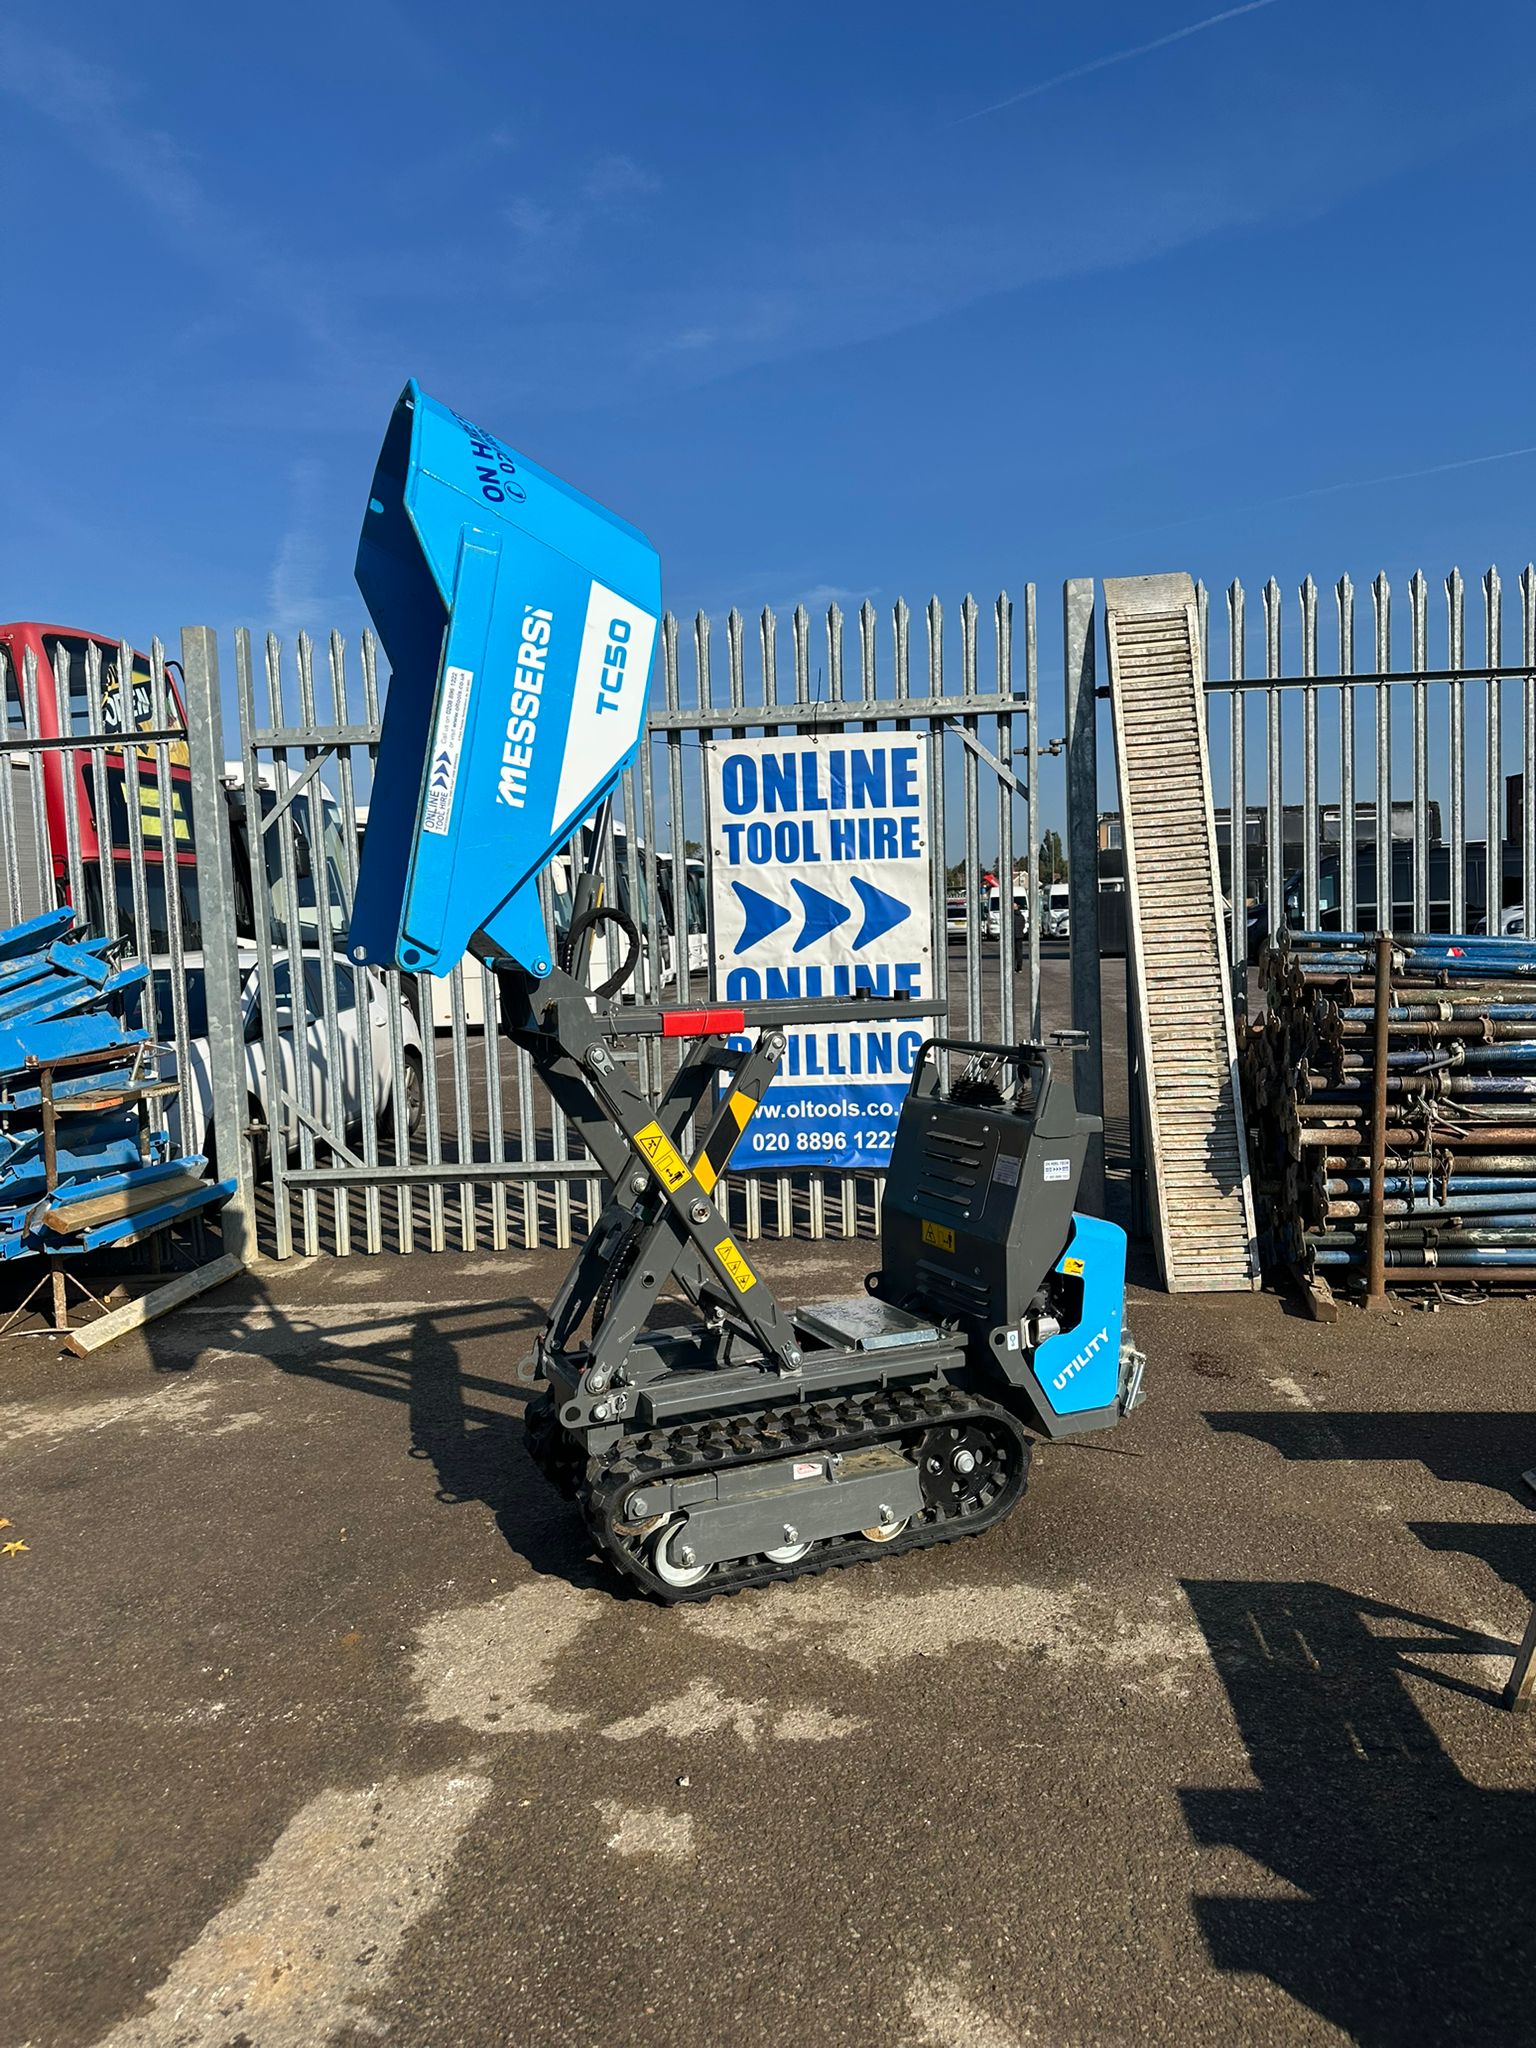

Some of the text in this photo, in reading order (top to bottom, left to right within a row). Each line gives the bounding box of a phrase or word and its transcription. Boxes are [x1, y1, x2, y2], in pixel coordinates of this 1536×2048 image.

[475, 465, 505, 503] ON
[596, 618, 631, 715] TC50
[722, 747, 919, 815] ONLINE
[424, 790, 440, 829] ONLINE
[435, 792, 448, 830] TOOL HIRE
[722, 816, 921, 865] TOOL HIRE
[728, 1031, 922, 1077] ILLING
[753, 1132, 789, 1151] 020
[797, 1131, 846, 1150] 8896
[1052, 1326, 1109, 1390] UTILITY
